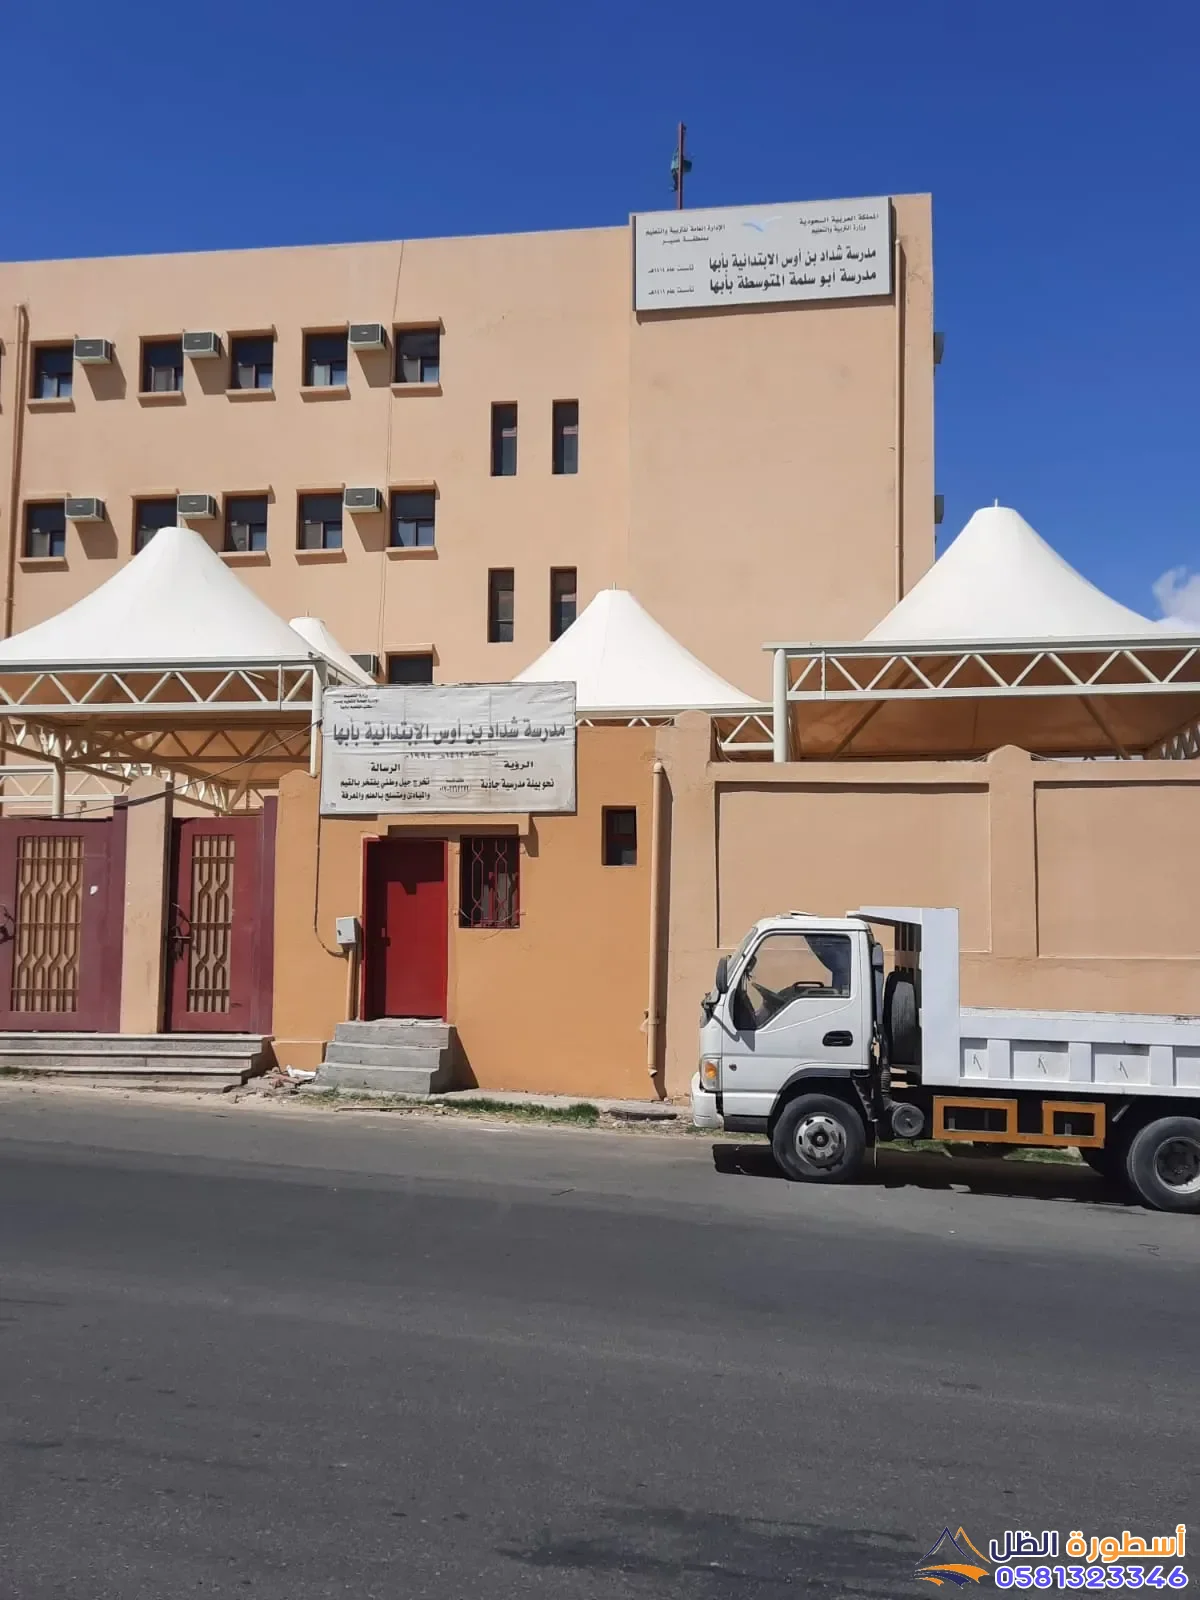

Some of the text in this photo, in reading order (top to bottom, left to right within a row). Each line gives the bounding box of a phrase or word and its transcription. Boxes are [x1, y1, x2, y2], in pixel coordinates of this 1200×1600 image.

[799, 216, 829, 226] السعودية
[831, 215, 856, 223] العربية
[781, 248, 802, 268] أوس
[804, 250, 817, 267] بن
[820, 244, 843, 261] شداد
[846, 245, 876, 262] مدرسة
[708, 252, 729, 273] بأبها
[737, 274, 785, 291] المتوسطة
[789, 271, 816, 285] سلمة
[840, 268, 877, 284] مدرسة
[709, 274, 734, 295] بأبها
[333, 717, 360, 746] بأبها
[433, 717, 461, 745] أوس
[488, 715, 519, 738] شداد
[524, 718, 566, 742] مدرسة
[465, 723, 483, 745] بن
[371, 762, 401, 774] الرسالة
[504, 760, 534, 771] الرؤية
[340, 777, 360, 789] بالقيم
[361, 778, 380, 789] يفتخر
[381, 779, 398, 788] وطني
[399, 777, 411, 788] جيل
[480, 778, 500, 791] جاذبة
[501, 778, 525, 790] مدرسية
[341, 790, 364, 801] والمعرفة
[366, 791, 384, 799] بالعلم
[385, 791, 406, 801] ومتسلح
